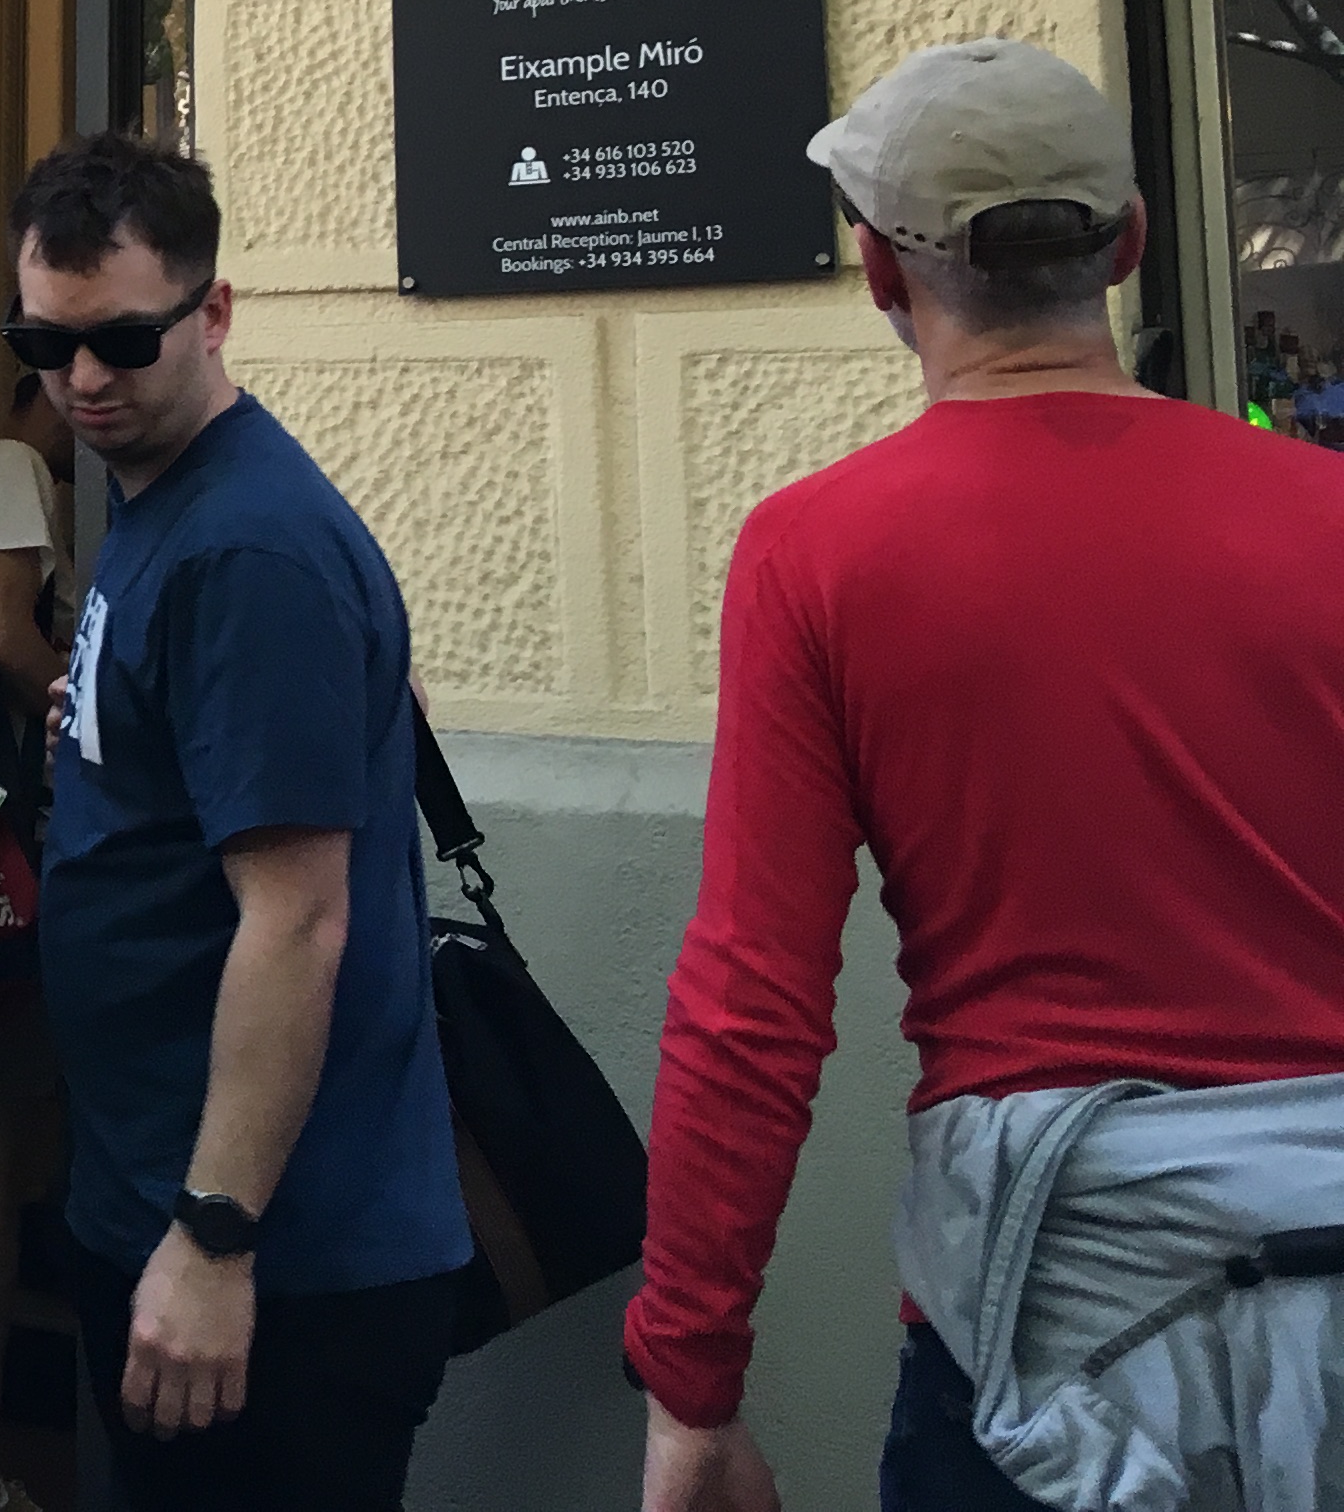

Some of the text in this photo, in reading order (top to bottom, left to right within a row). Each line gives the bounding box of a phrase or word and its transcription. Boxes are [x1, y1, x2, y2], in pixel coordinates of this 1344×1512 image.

[500, 37, 704, 81] Eixample Miró
[534, 78, 669, 108] Entença, 140
[562, 139, 695, 164] +34 616 103 520
[562, 158, 697, 181] +34 933 106 623
[550, 208, 660, 228] www.ainb.net
[492, 234, 547, 252] Central
[551, 232, 634, 251] Reception:
[637, 229, 688, 247] Jaume
[705, 224, 724, 240] 13
[500, 246, 715, 274] Bookings: +34 934 395 664
